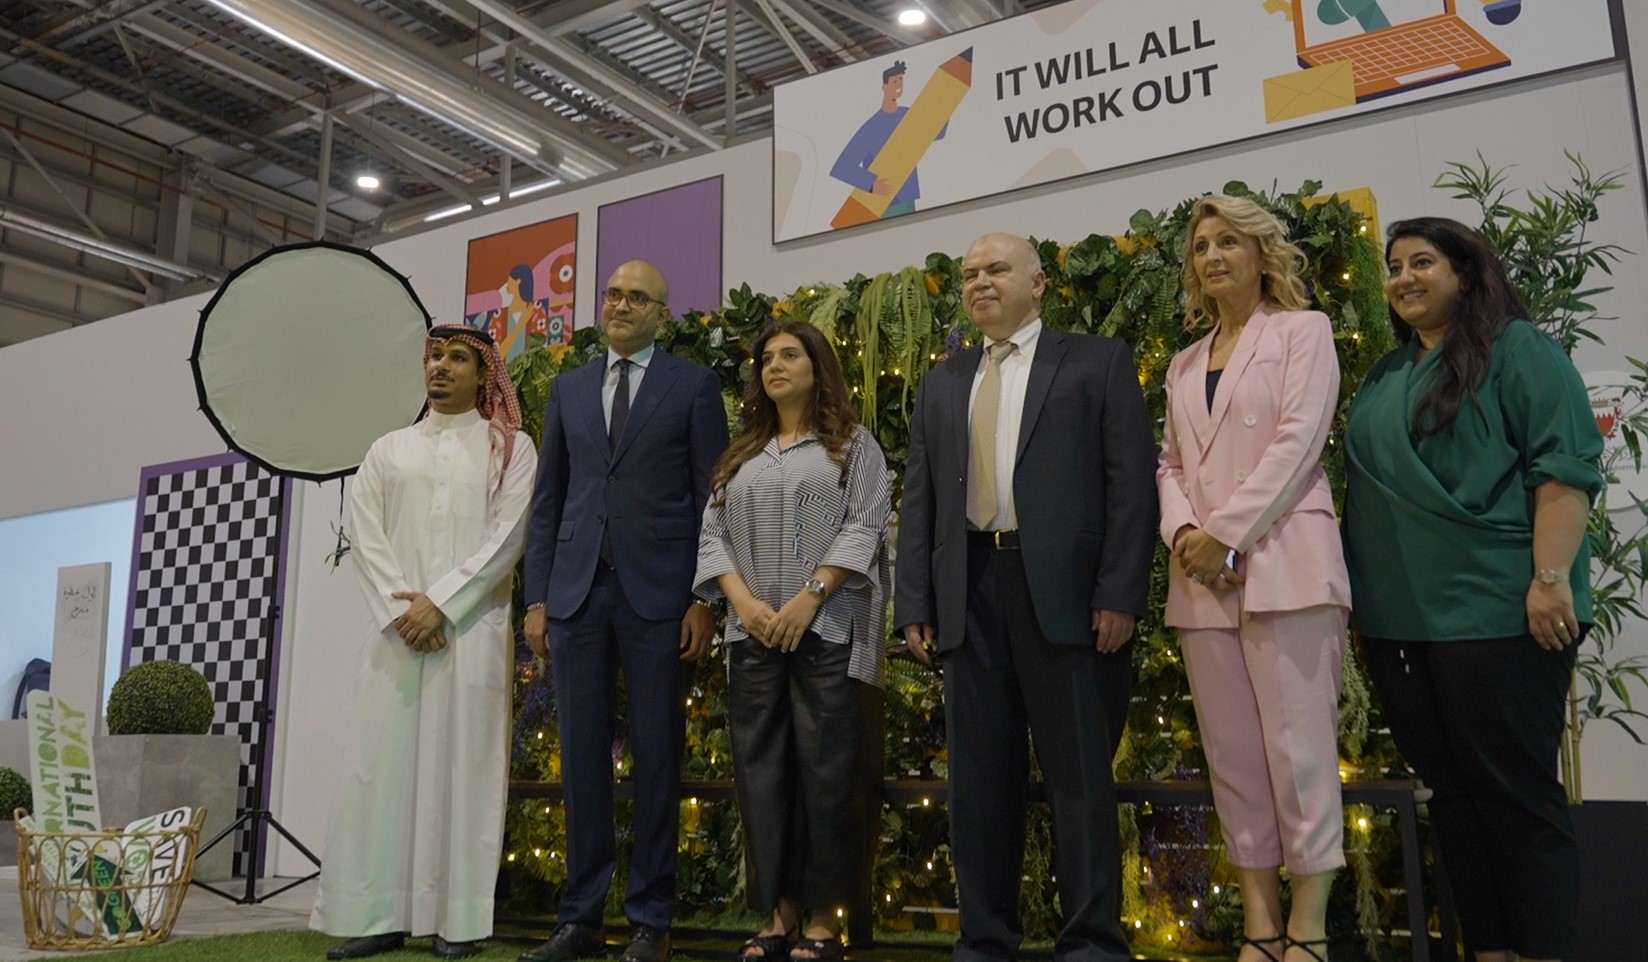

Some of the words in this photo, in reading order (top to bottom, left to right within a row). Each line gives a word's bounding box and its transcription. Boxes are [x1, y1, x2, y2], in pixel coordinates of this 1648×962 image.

[996, 66, 1028, 101] IT
[1034, 42, 1130, 90] WILL
[1138, 19, 1216, 64] ALL
[1004, 87, 1124, 143] WORK
[1132, 63, 1219, 112] OUT
